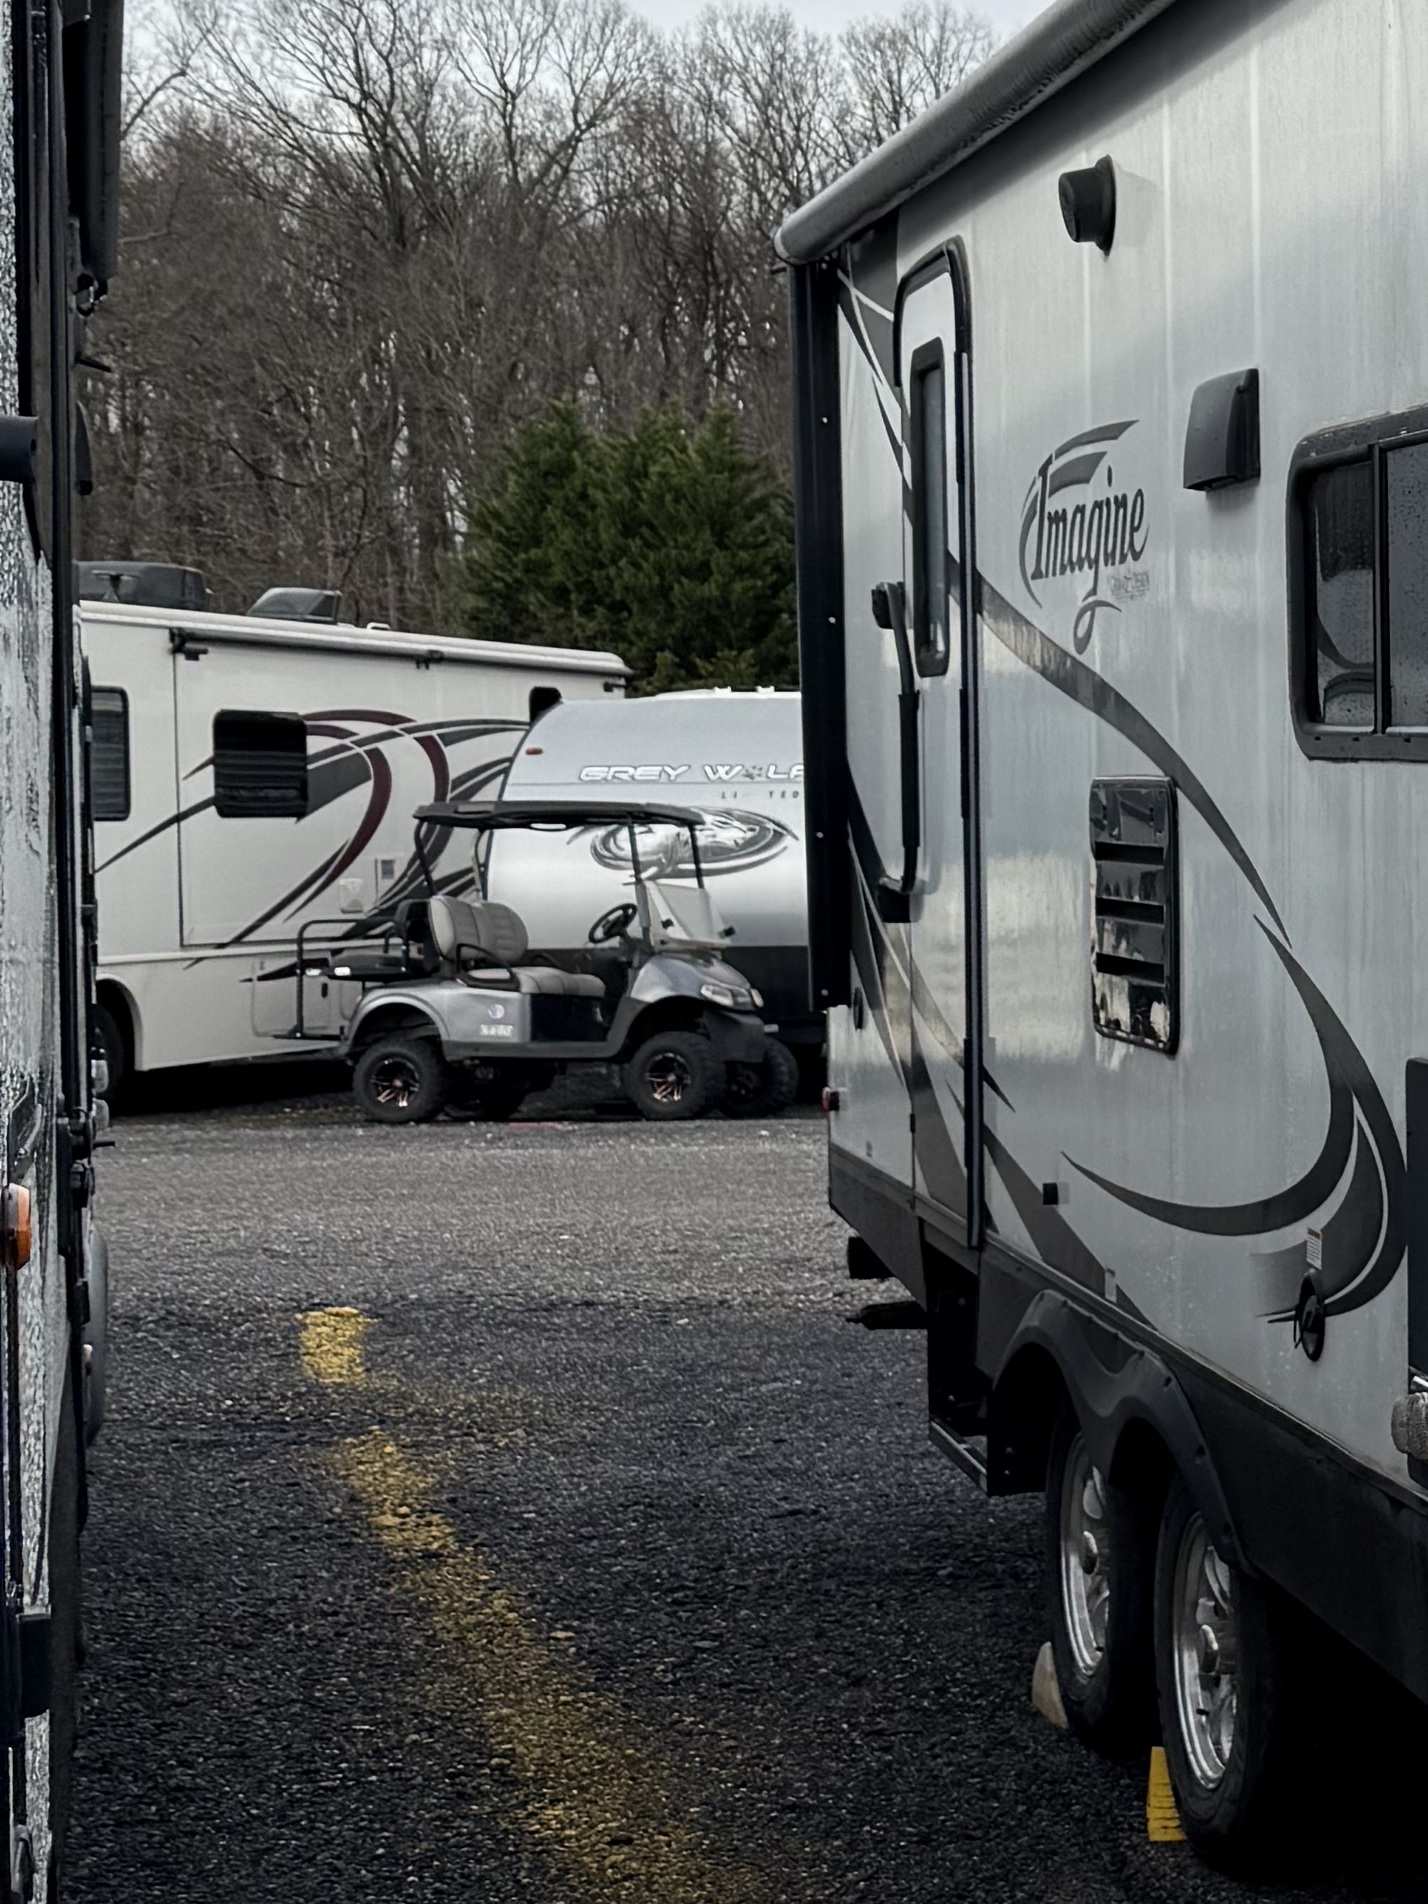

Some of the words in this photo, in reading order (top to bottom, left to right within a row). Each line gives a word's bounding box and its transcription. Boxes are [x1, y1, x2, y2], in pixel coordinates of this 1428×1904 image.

[1030, 452, 1150, 656] Imagine
[579, 764, 691, 781] GREY
[703, 763, 804, 781] WLF
[721, 790, 800, 799] LITED
